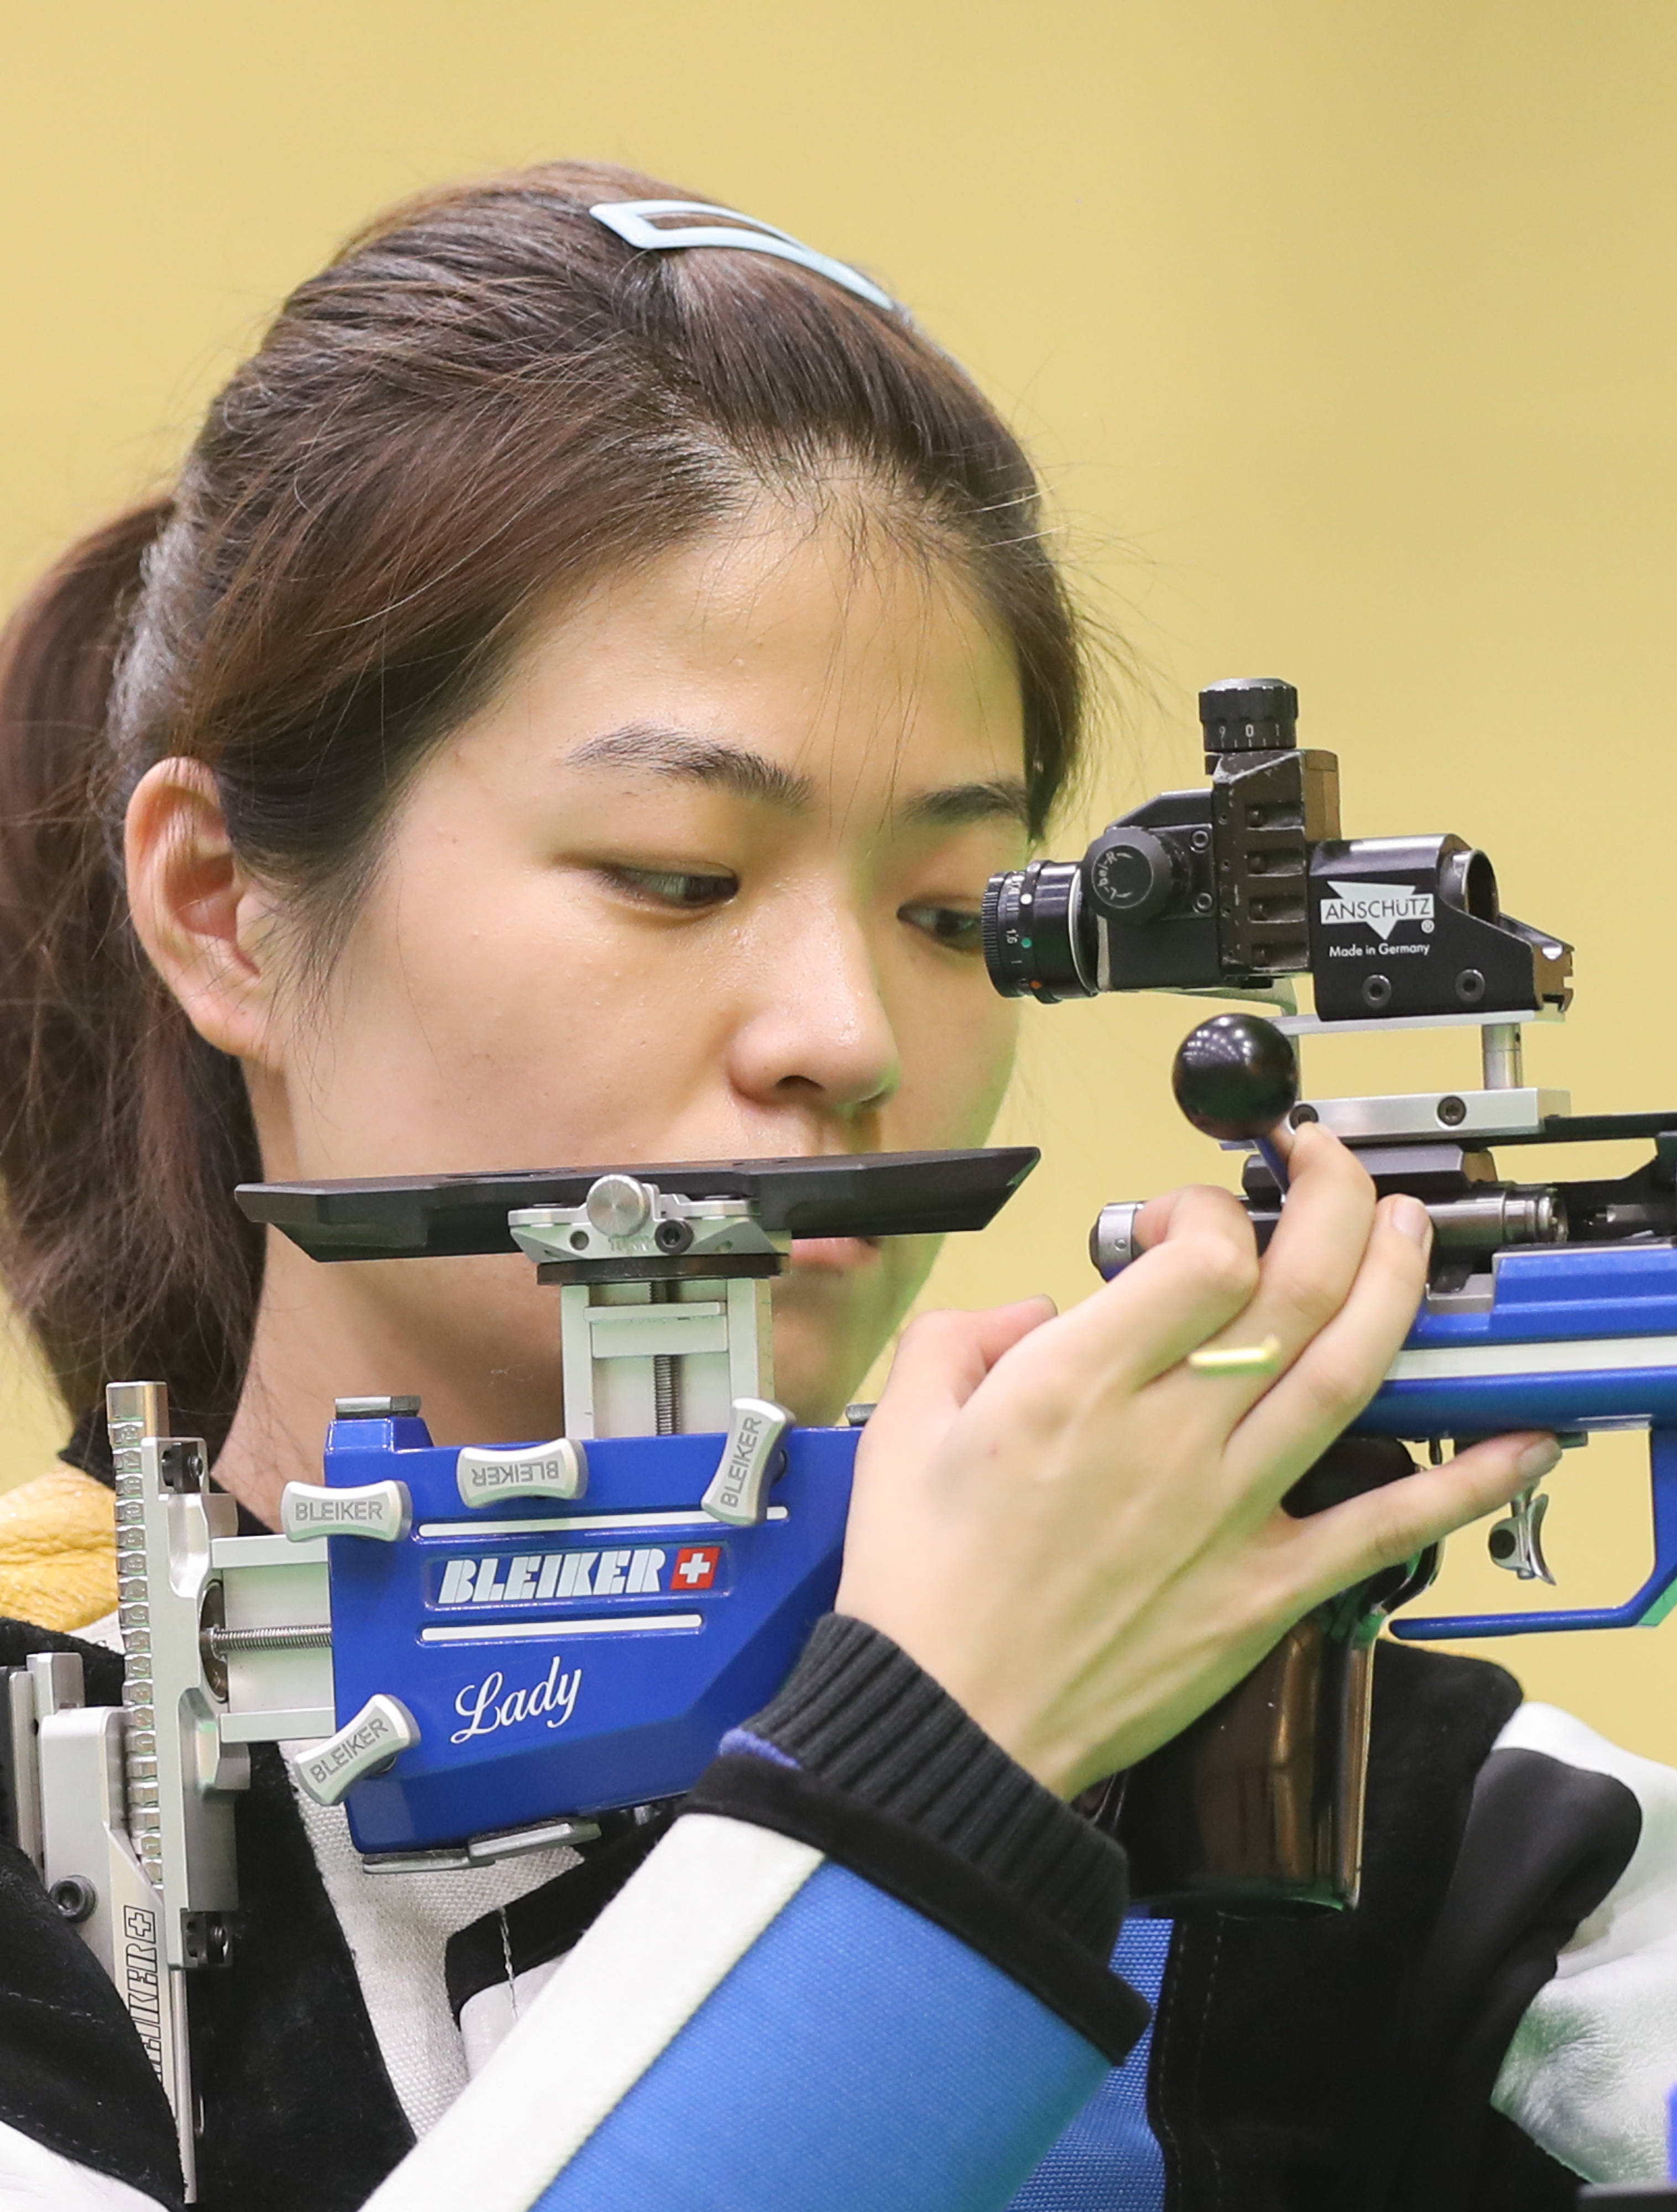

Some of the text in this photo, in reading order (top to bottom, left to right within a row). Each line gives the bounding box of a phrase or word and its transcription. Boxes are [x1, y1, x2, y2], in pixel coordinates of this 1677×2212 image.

[1218, 723, 1280, 739] 9 0 1
[1325, 897, 1430, 920] ANSCHÜTZ
[1329, 942, 1430, 957] Made in Germany
[471, 1460, 559, 1487] BLEIKER
[720, 1416, 762, 1508] BLEIKER
[295, 1501, 383, 1521] BLEIKER
[439, 1548, 666, 1604] BLEIKER
[450, 1656, 581, 1744] Lady
[310, 1718, 388, 1783] BLEIKER
